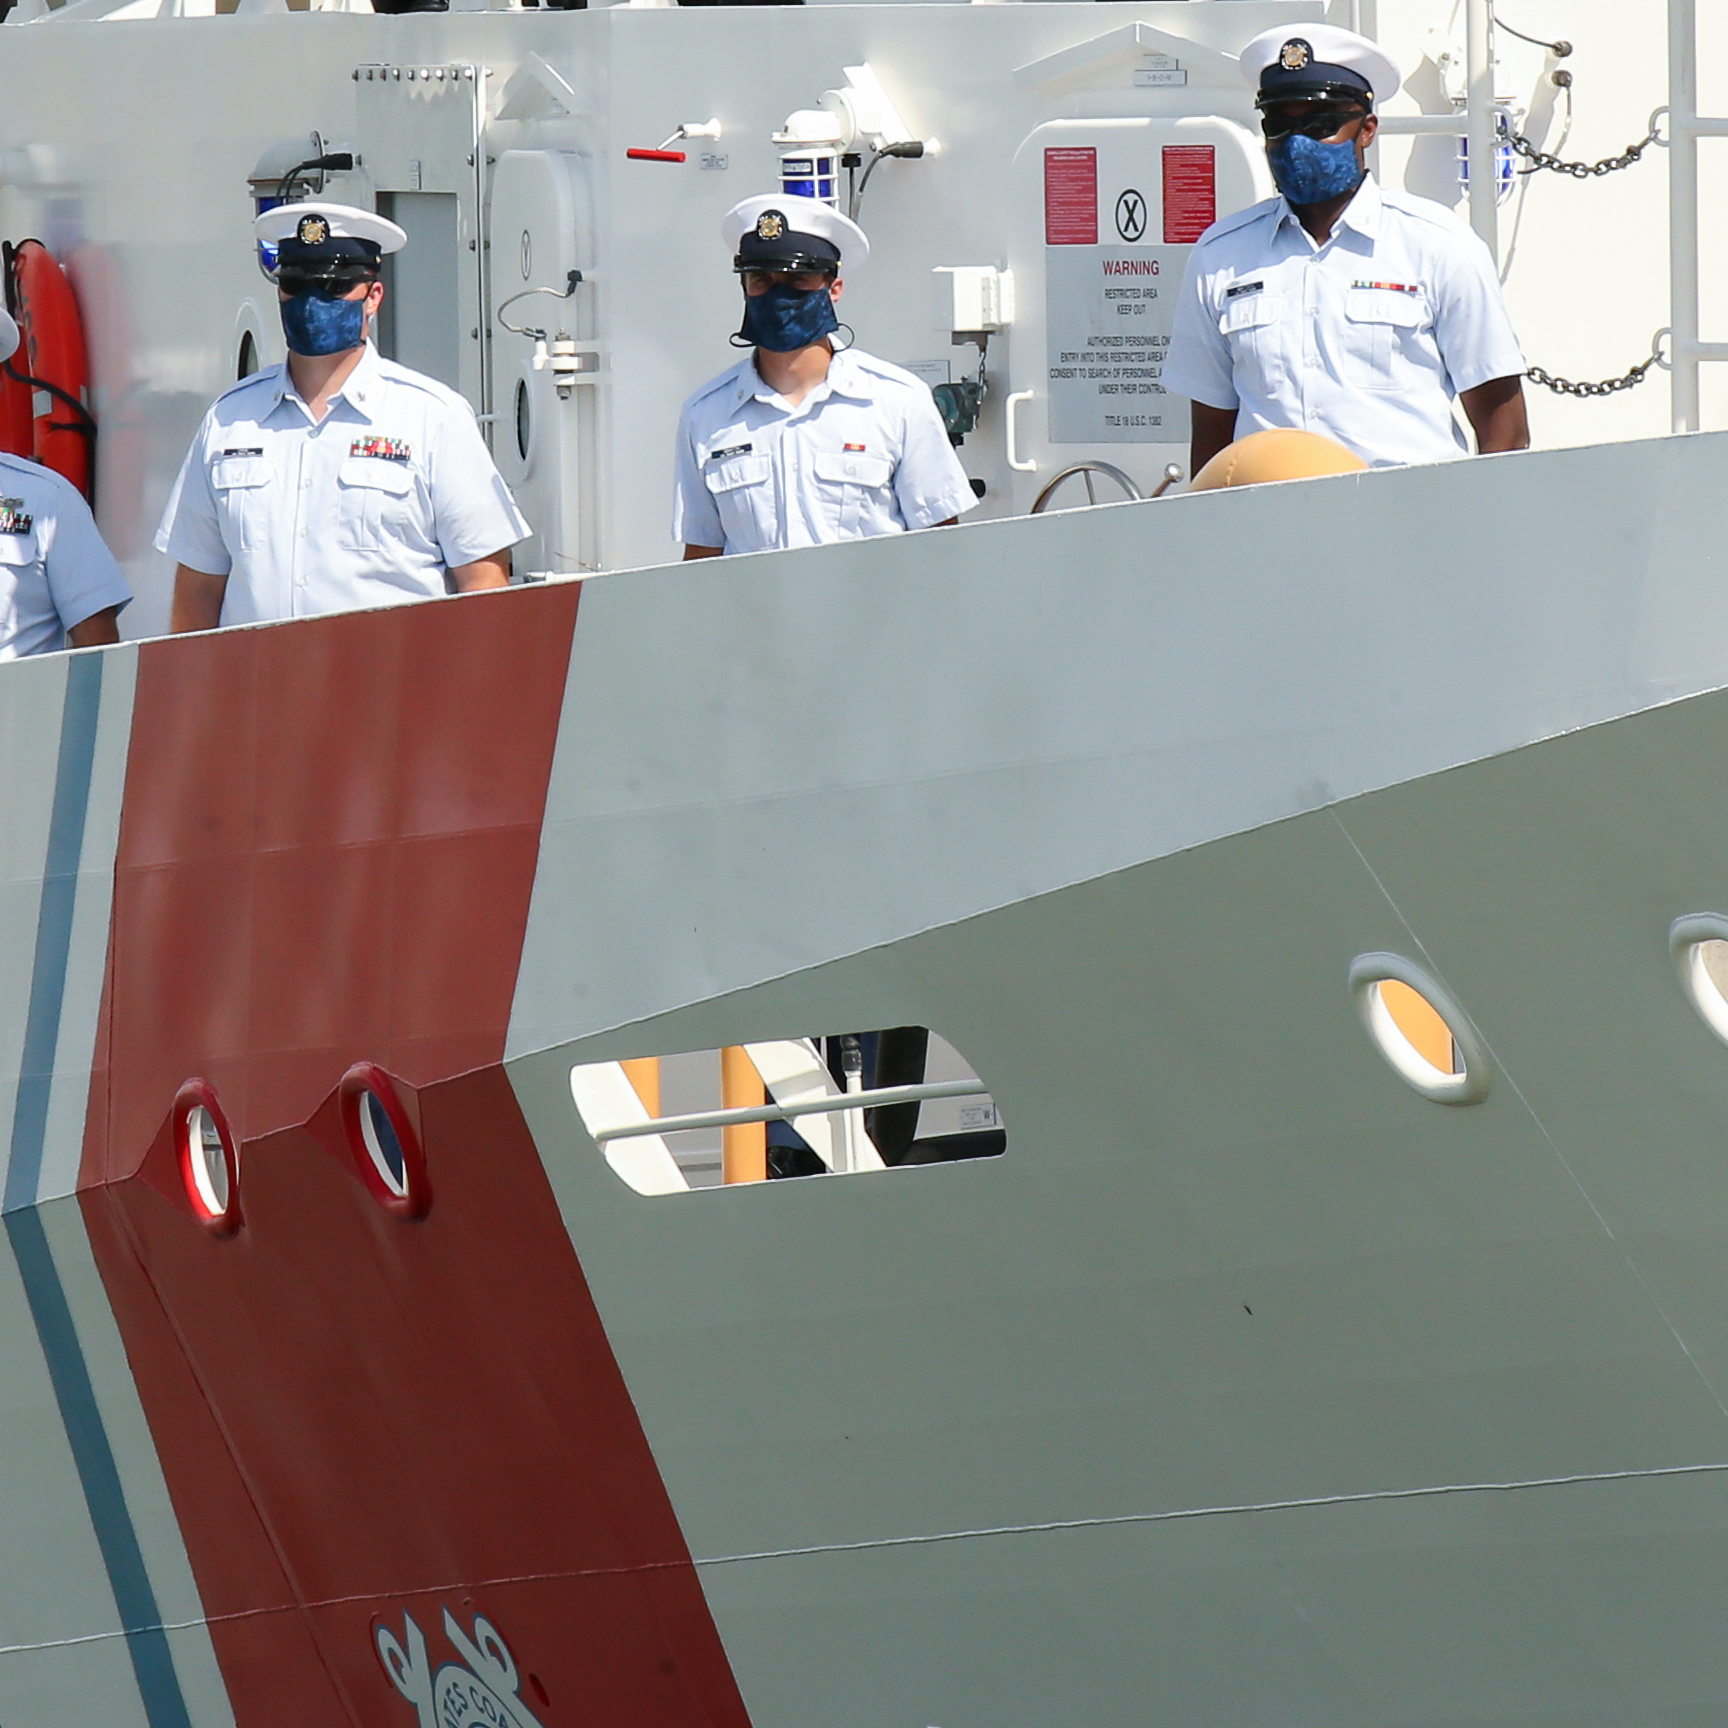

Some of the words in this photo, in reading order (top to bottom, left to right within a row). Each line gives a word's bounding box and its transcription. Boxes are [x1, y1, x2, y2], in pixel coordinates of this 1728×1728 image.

[1102, 260, 1160, 276] WARNING
[1104, 288, 1142, 299] RESTRICTED
[1142, 288, 1158, 299] AREA
[1117, 304, 1133, 315] KEEP
[1133, 304, 1146, 315] OUT
[1087, 336, 1124, 346] AUTHORIZED
[1125, 336, 1161, 346] PERSONNEL
[1161, 336, 1171, 346] ON
[1060, 352, 1079, 363] ENTRY
[1080, 352, 1094, 363] INTO
[1095, 352, 1109, 363] THIS
[1110, 352, 1146, 363] RESTRICTED
[1147, 352, 1163, 363] AREA
[1050, 368, 1078, 378] CONSENT
[1079, 368, 1087, 378] TO
[1088, 368, 1112, 378] SEARCH
[1112, 368, 1121, 378] OF
[1122, 368, 1157, 378] PERSONNEL
[1098, 384, 1119, 394] UNDER
[1120, 384, 1137, 394] THEIR
[1105, 415, 1121, 426] TITLE
